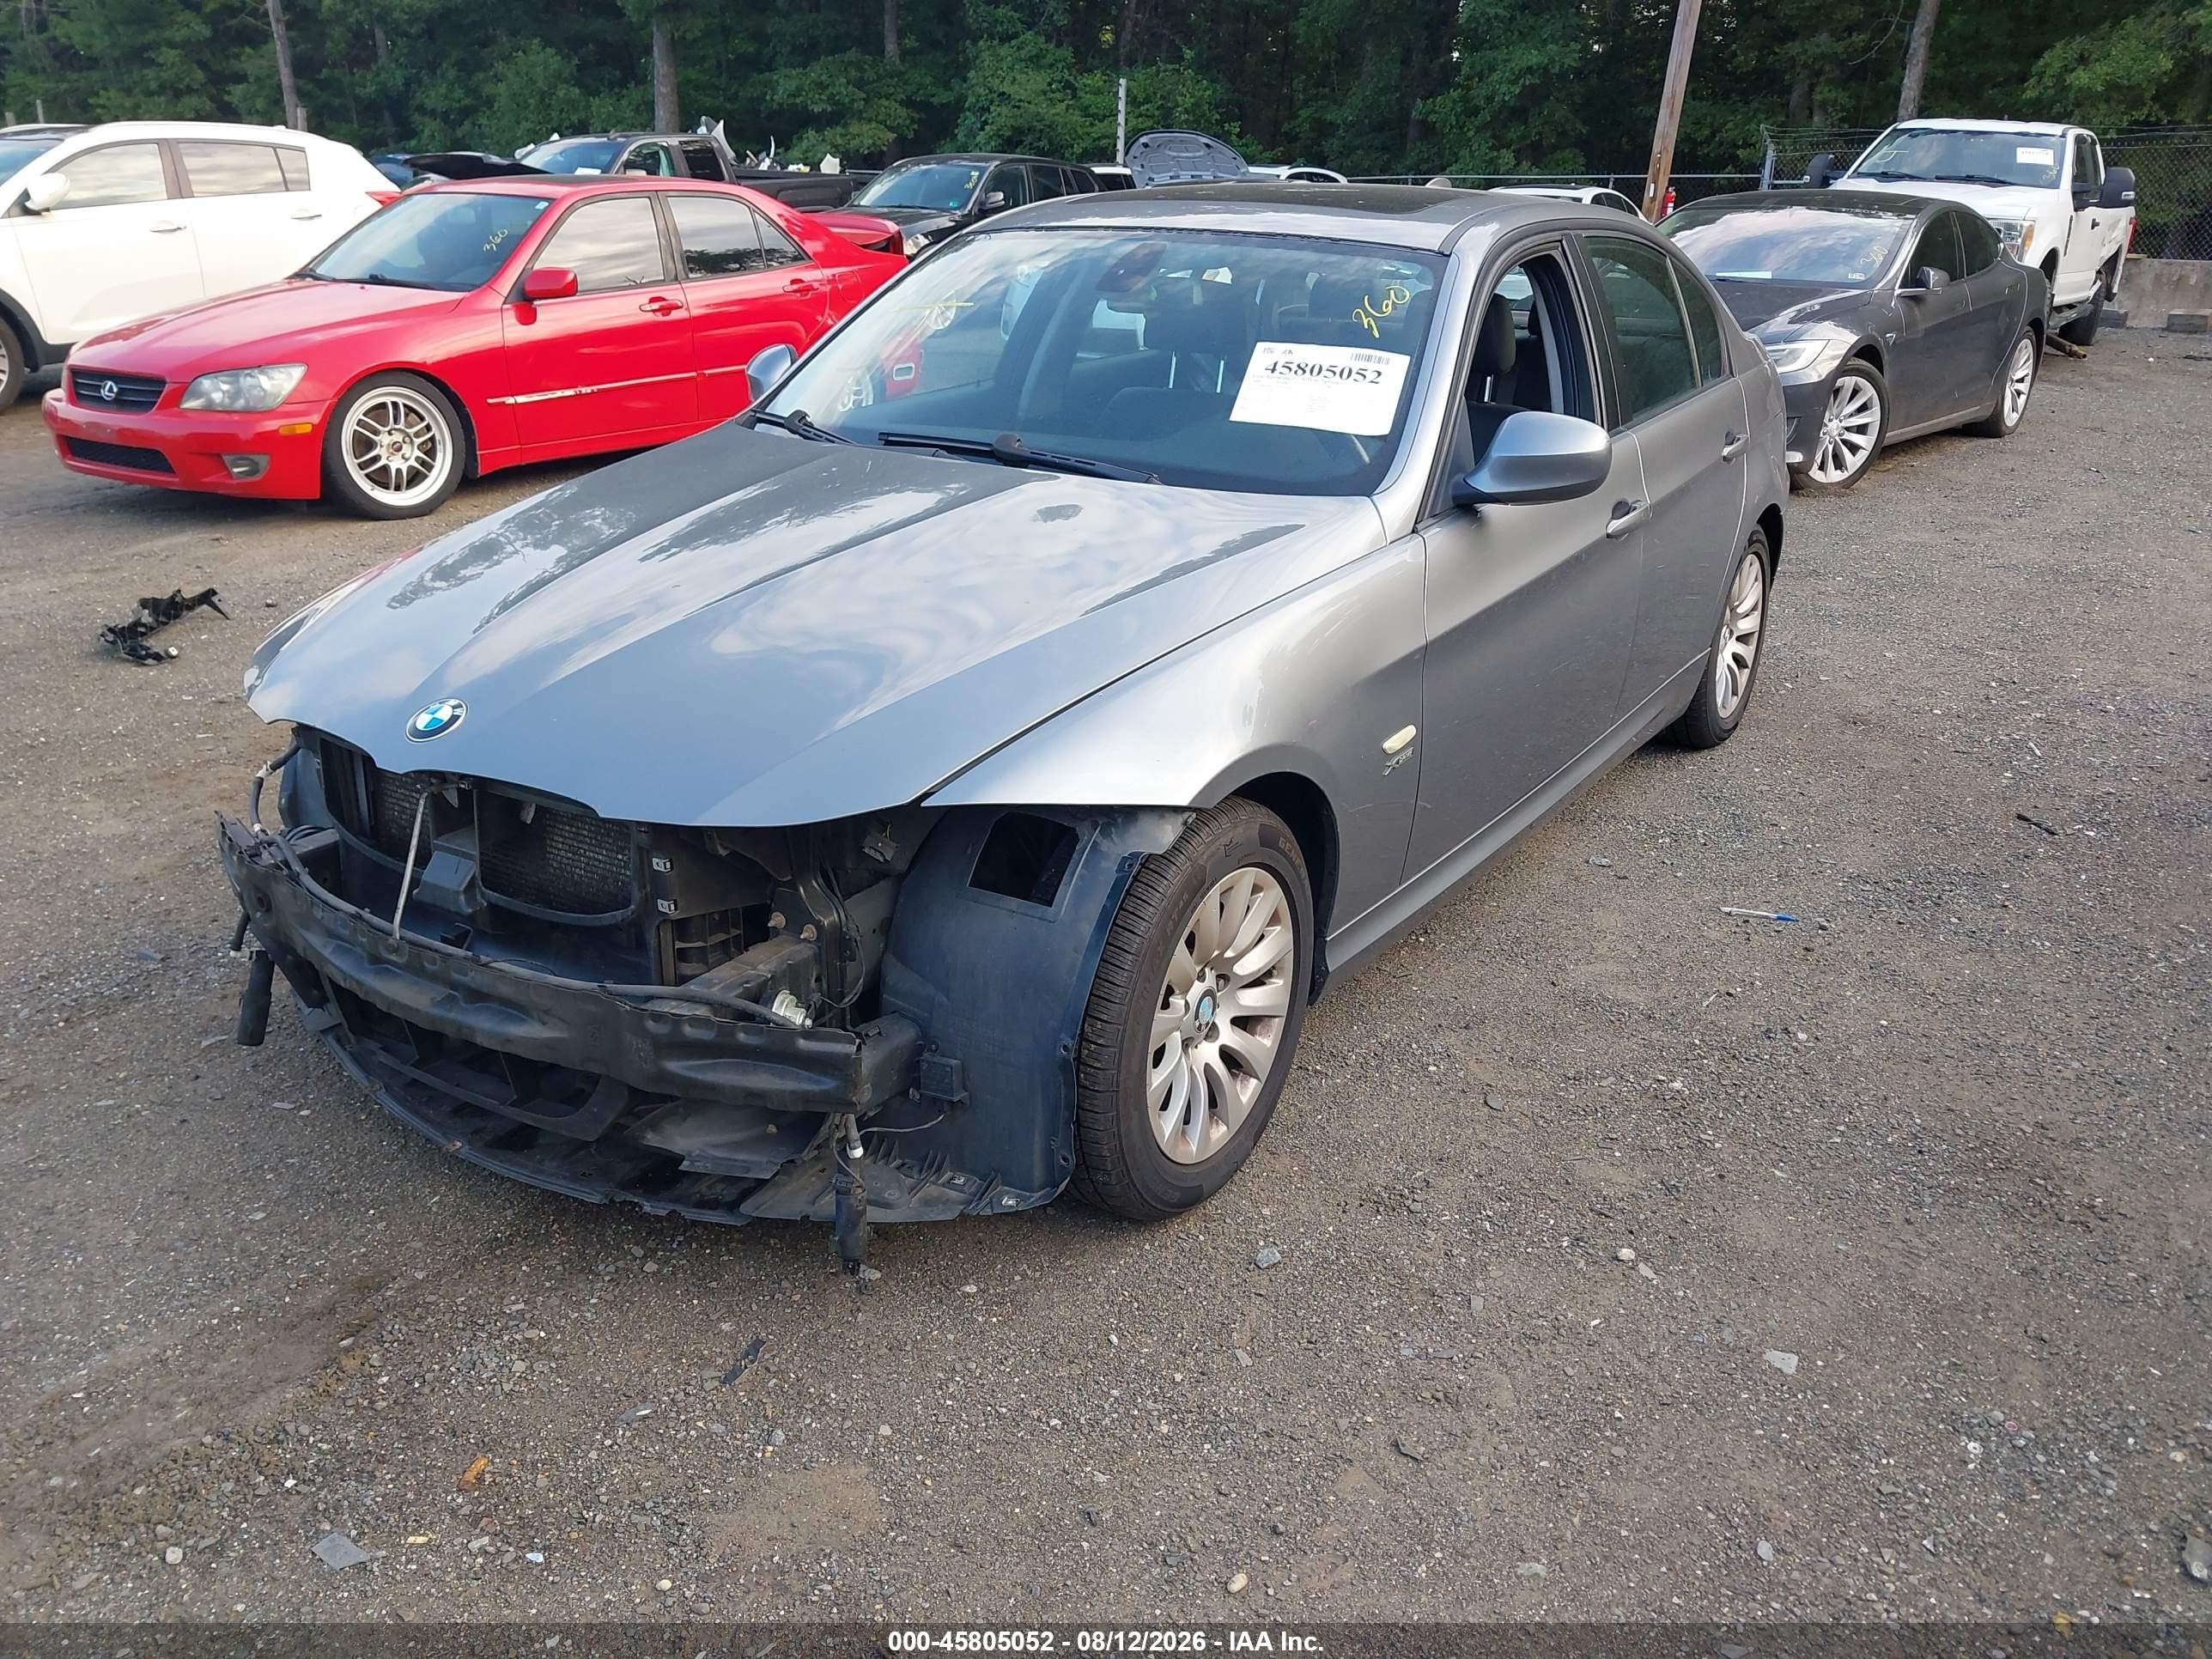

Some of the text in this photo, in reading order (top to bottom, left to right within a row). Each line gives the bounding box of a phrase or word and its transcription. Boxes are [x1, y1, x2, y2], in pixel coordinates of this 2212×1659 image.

[483, 228, 508, 252] 360
[1352, 285, 1410, 338] 360
[1264, 361, 1383, 385] 45805052
